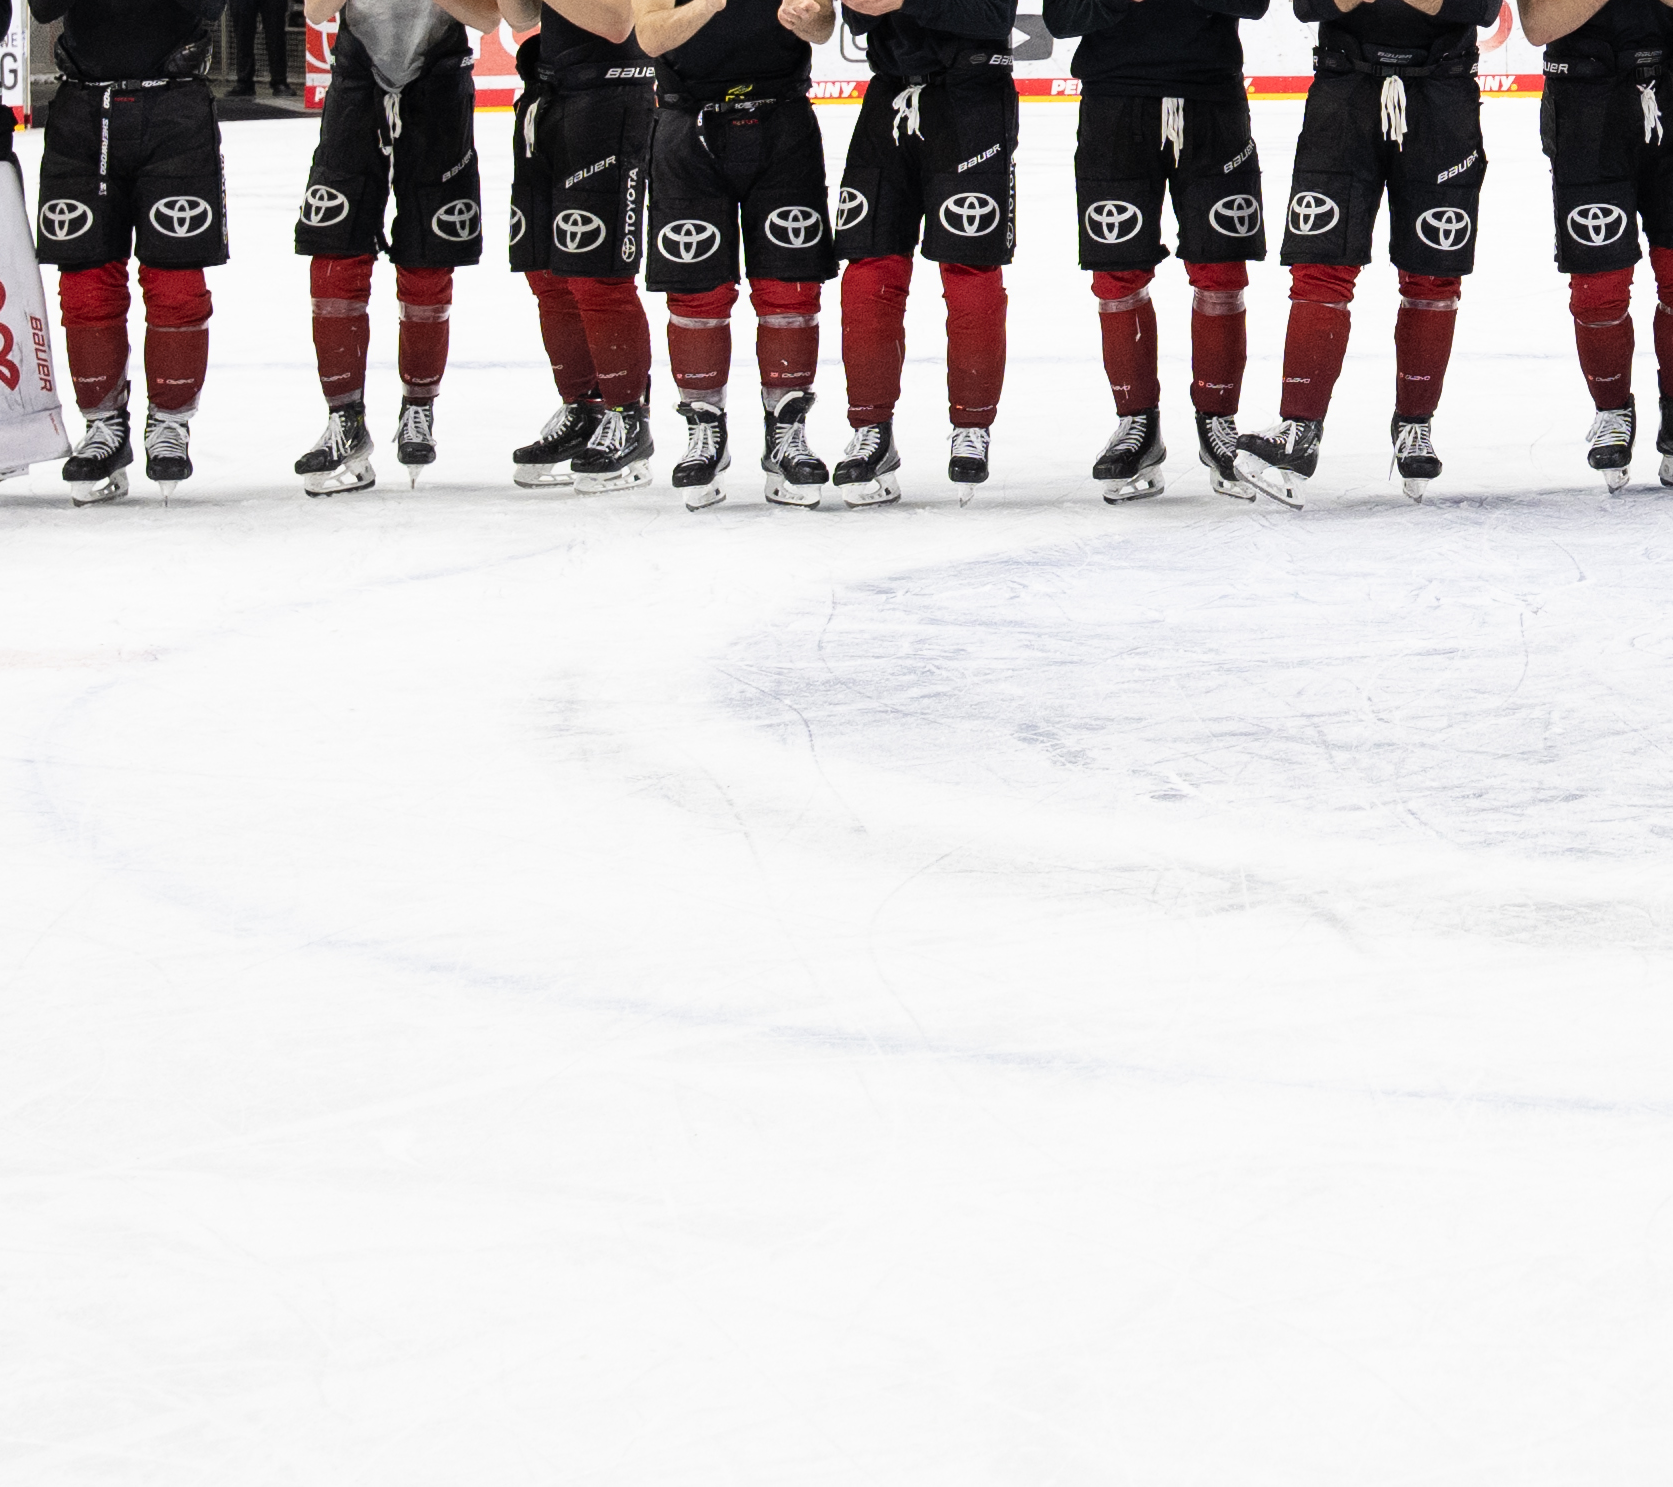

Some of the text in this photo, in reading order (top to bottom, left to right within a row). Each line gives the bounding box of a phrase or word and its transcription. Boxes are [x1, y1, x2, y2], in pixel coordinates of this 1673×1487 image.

[605, 67, 655, 79] BAUE
[565, 155, 617, 189] BAUER
[957, 143, 1002, 173] BAUER
[1436, 149, 1479, 185] BAUER
[625, 168, 639, 232] TOYOTA
[29, 315, 54, 394] BAUER
